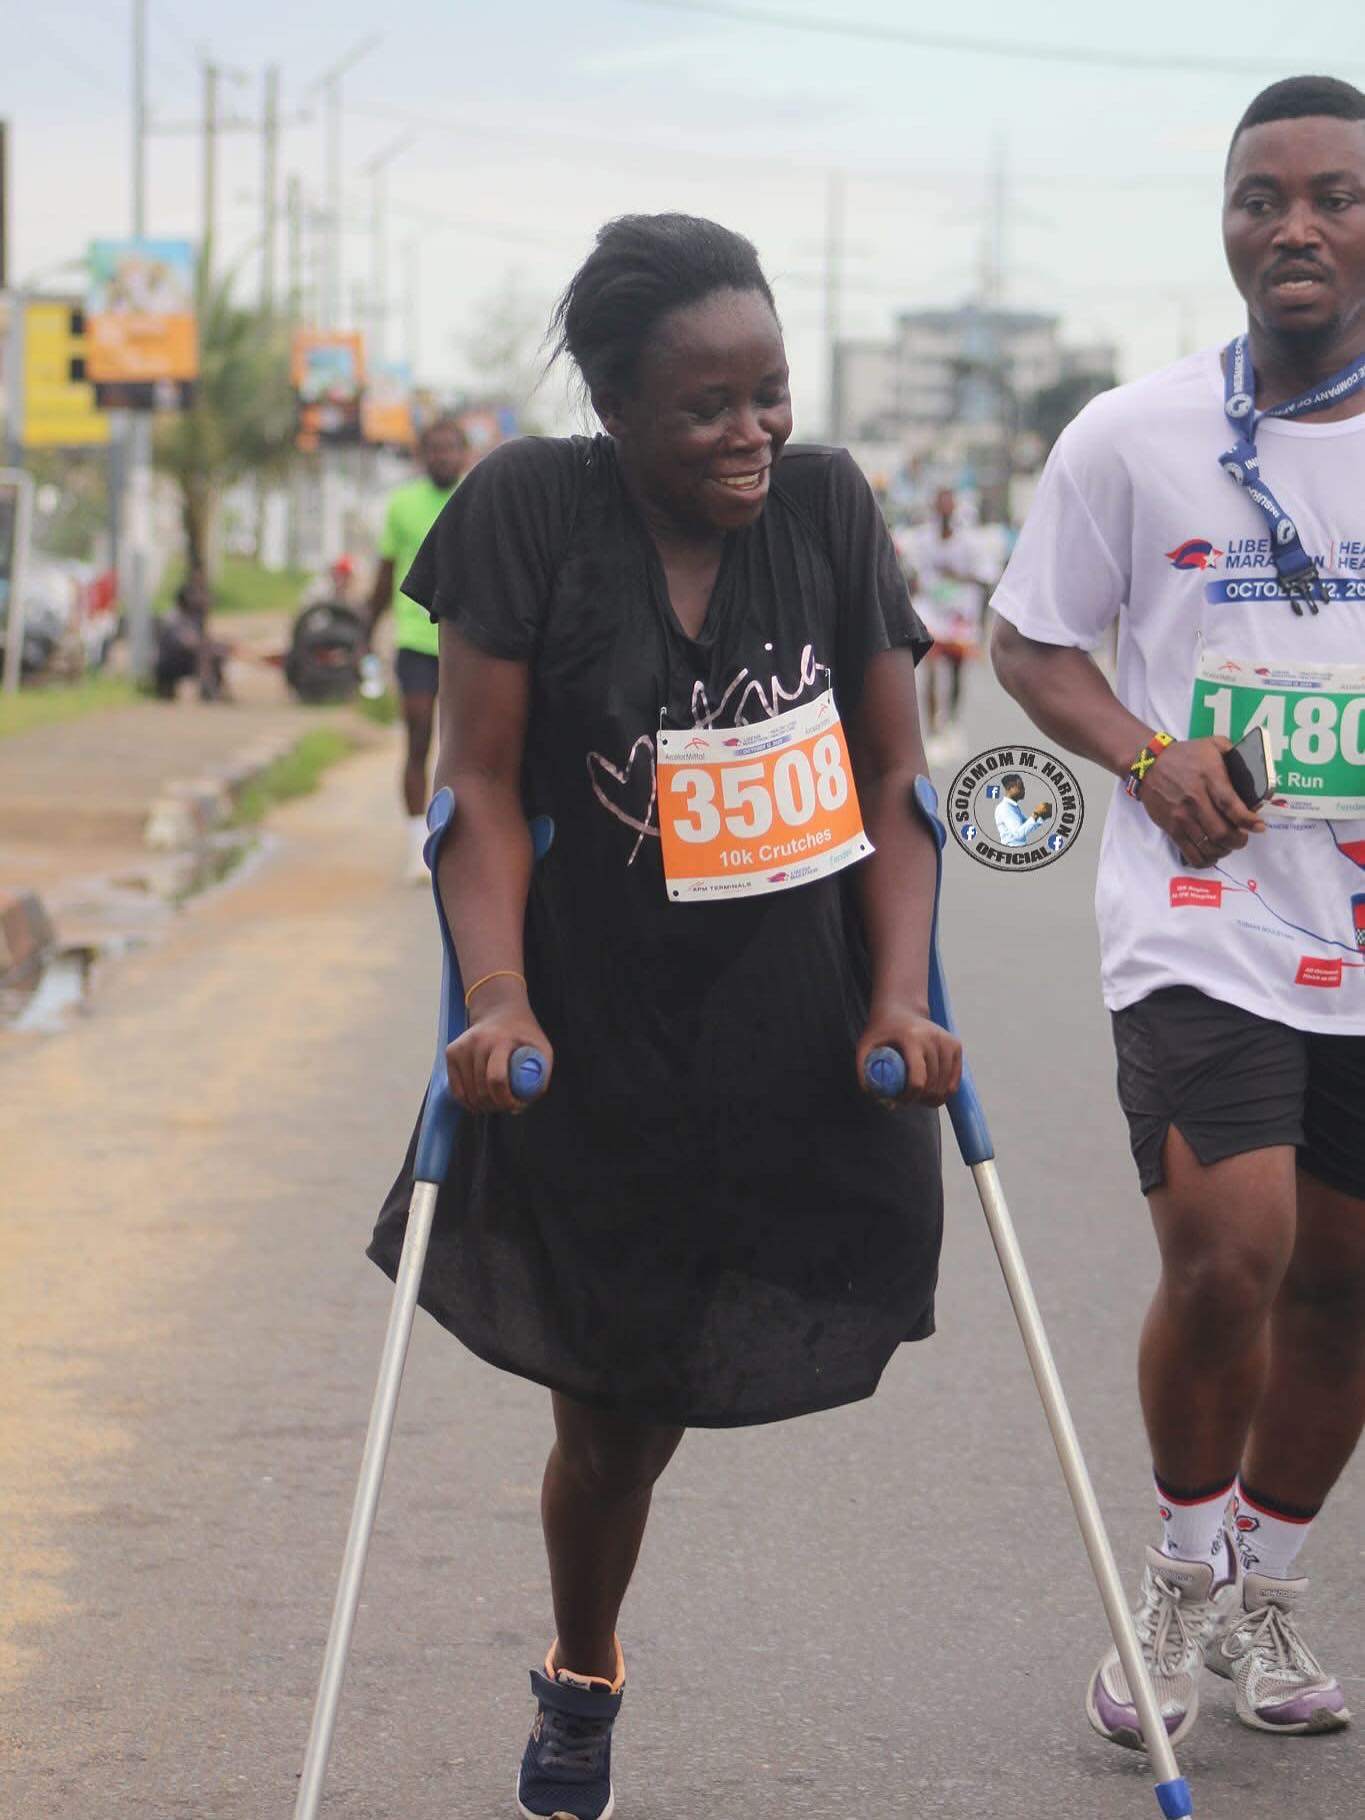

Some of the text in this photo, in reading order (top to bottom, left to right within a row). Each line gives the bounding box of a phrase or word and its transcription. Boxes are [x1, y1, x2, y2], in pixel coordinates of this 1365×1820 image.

[1314, 373, 1359, 403] COMPANY
[1228, 539, 1269, 554] LIBE
[671, 734, 848, 843] 3508
[1288, 771, 1324, 788] Run
[720, 850, 753, 868] 10k
[758, 829, 833, 862] Crutches
